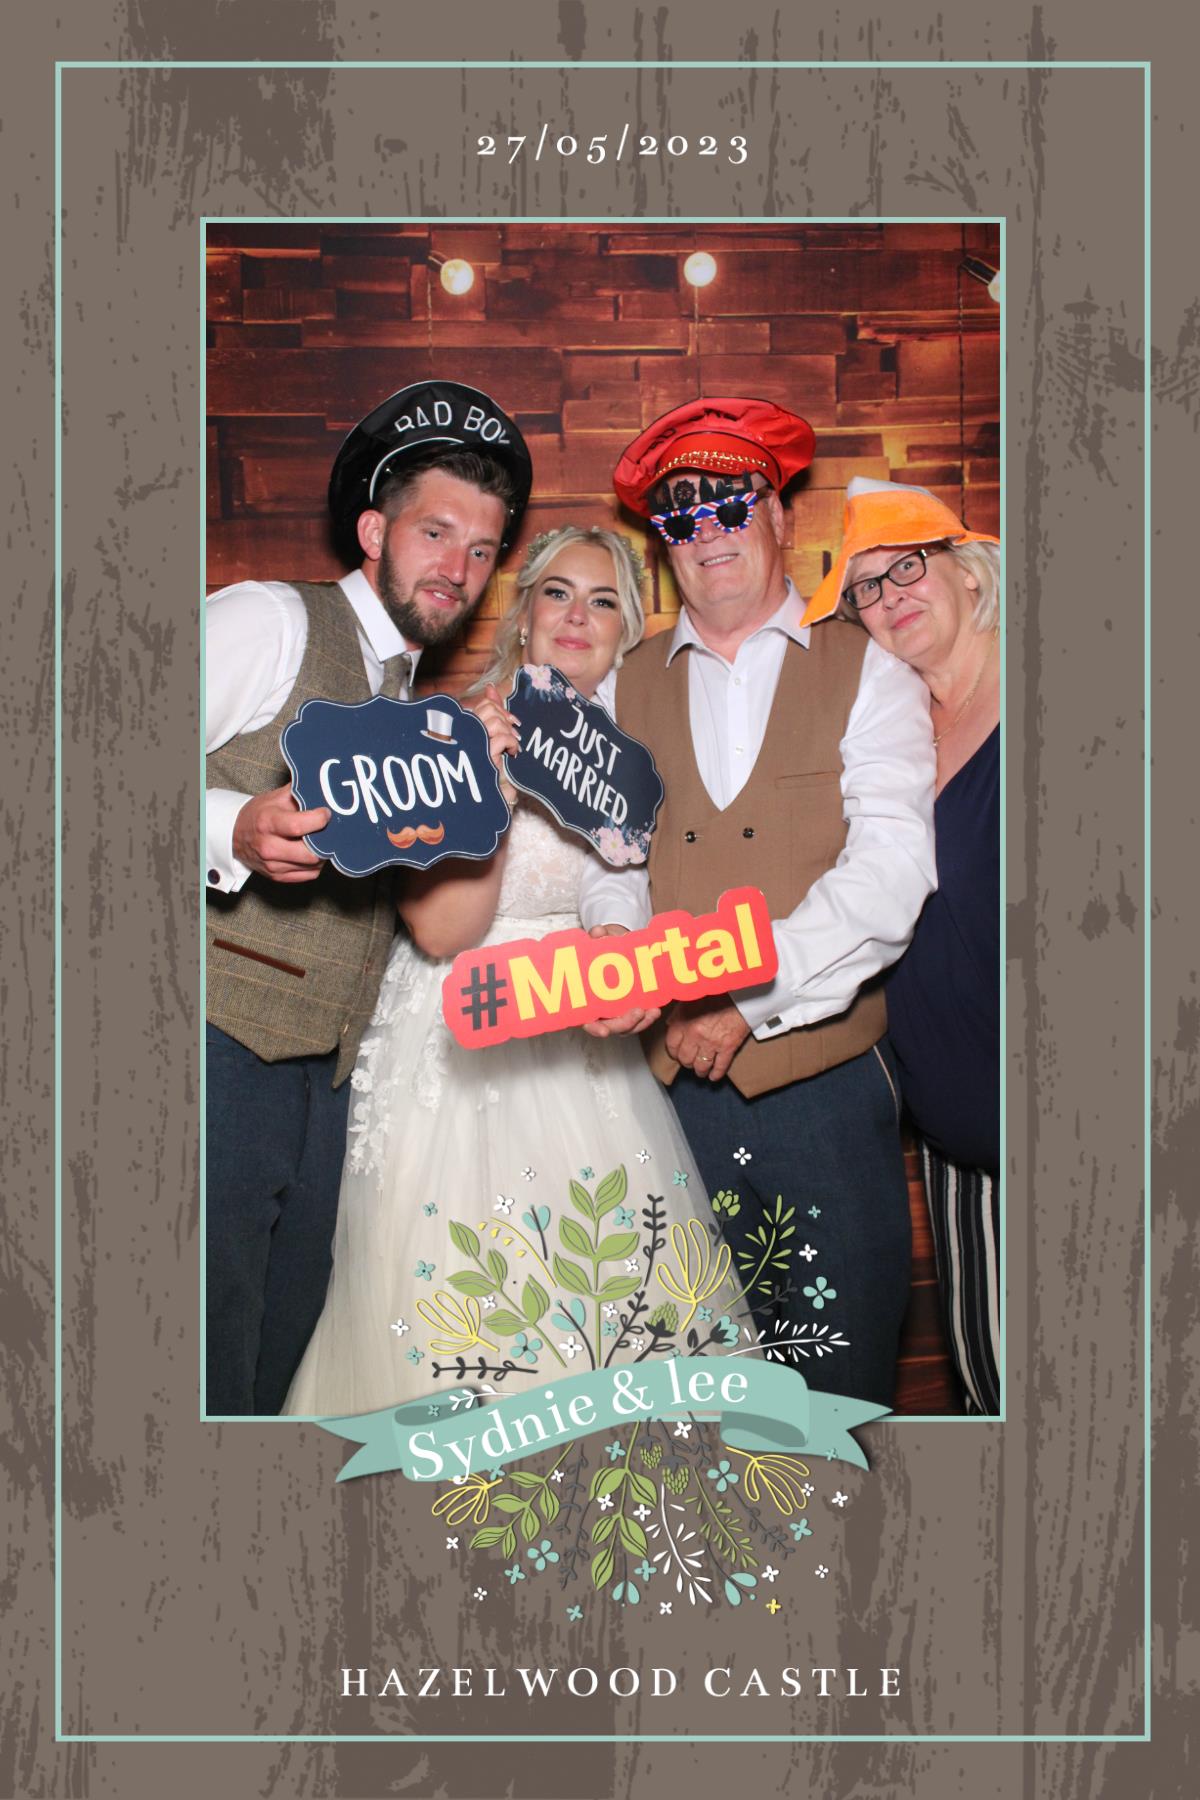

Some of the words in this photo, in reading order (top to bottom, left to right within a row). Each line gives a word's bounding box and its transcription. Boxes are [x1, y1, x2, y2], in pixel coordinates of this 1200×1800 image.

[526, 727, 628, 825] MARRIED
[559, 704, 622, 776] JUST
[319, 750, 482, 824] GROOM
[460, 903, 763, 1031] #Mortal
